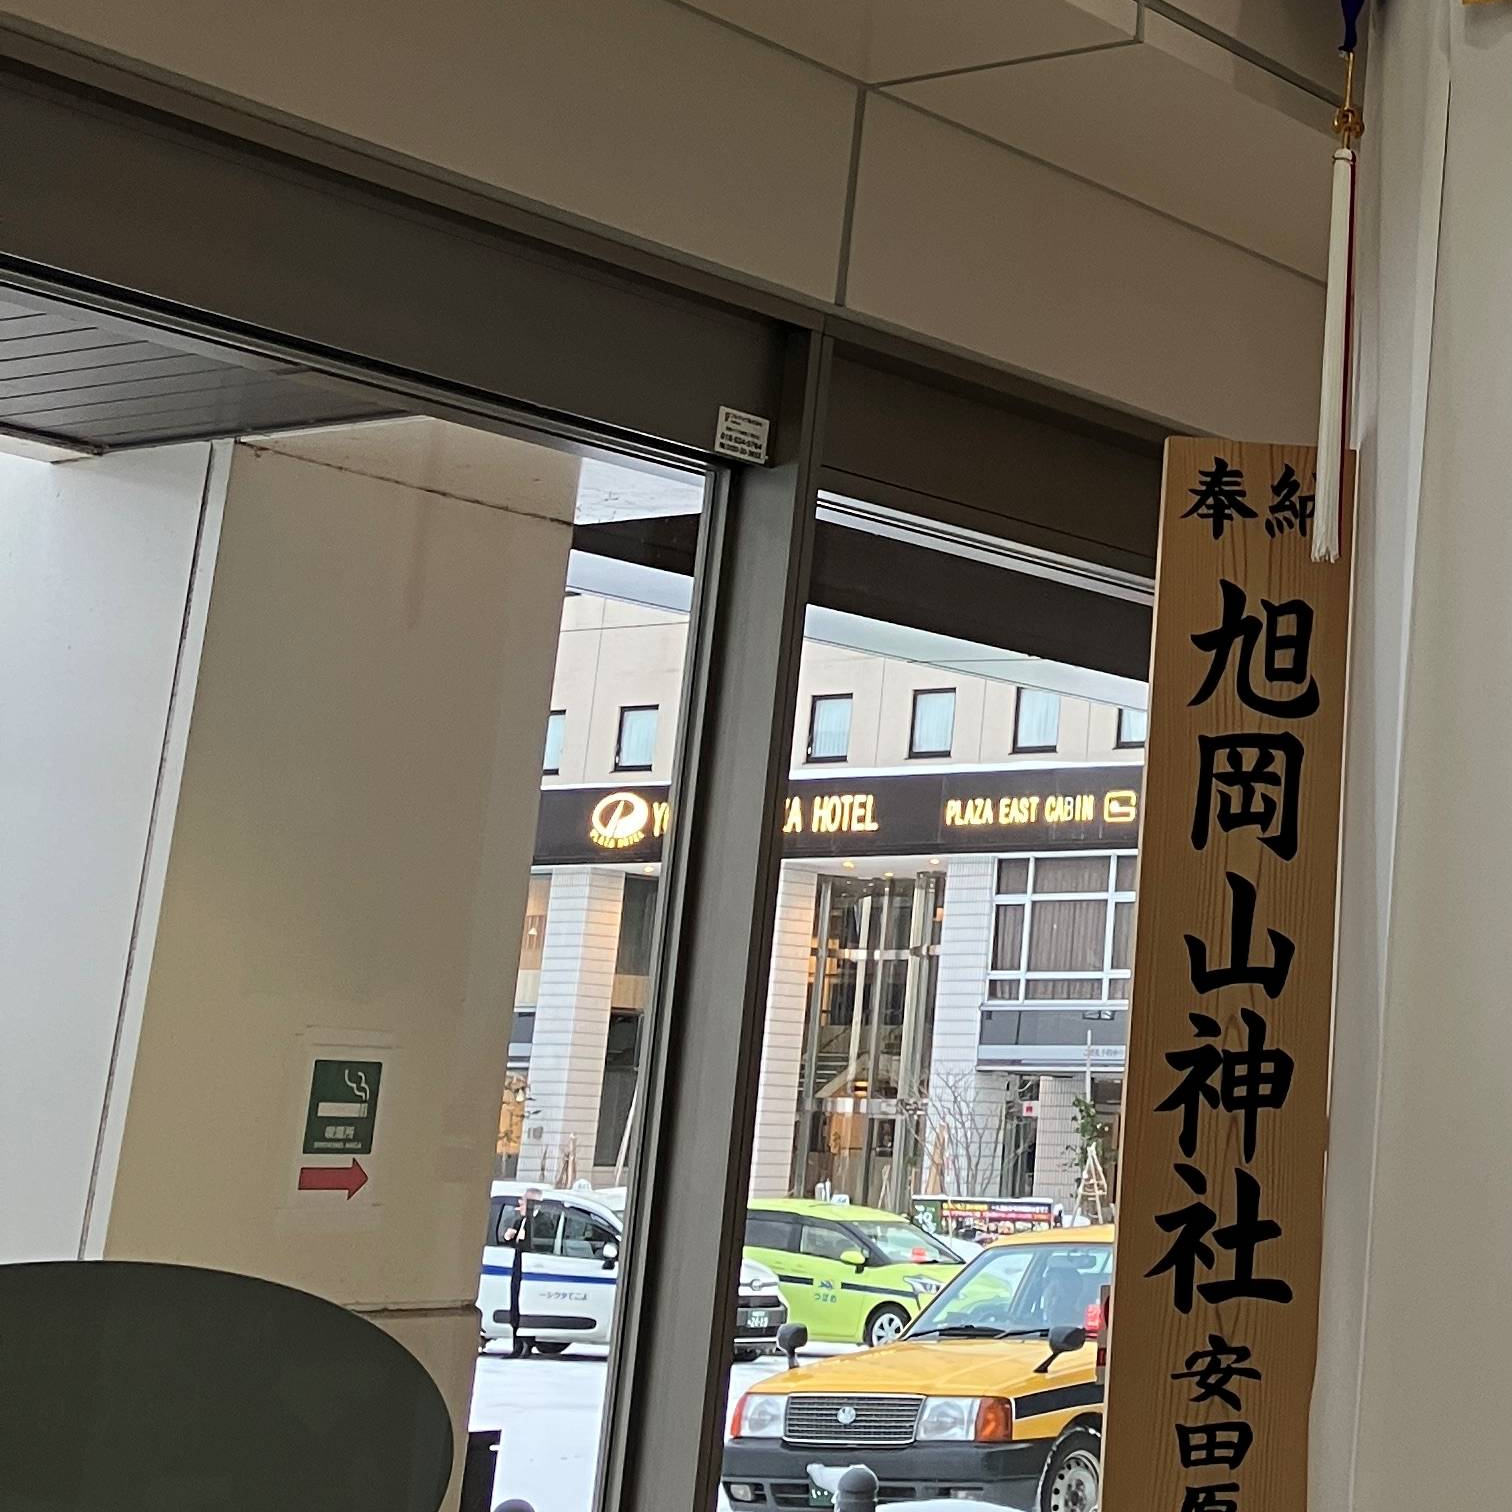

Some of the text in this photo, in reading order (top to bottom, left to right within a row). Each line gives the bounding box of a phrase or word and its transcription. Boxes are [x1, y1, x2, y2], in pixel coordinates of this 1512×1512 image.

[811, 794, 879, 833] HOTEL
[945, 794, 1095, 826] PLAZA EAST CABIN
[1143, 578, 1320, 1316] 旭岡山神社
